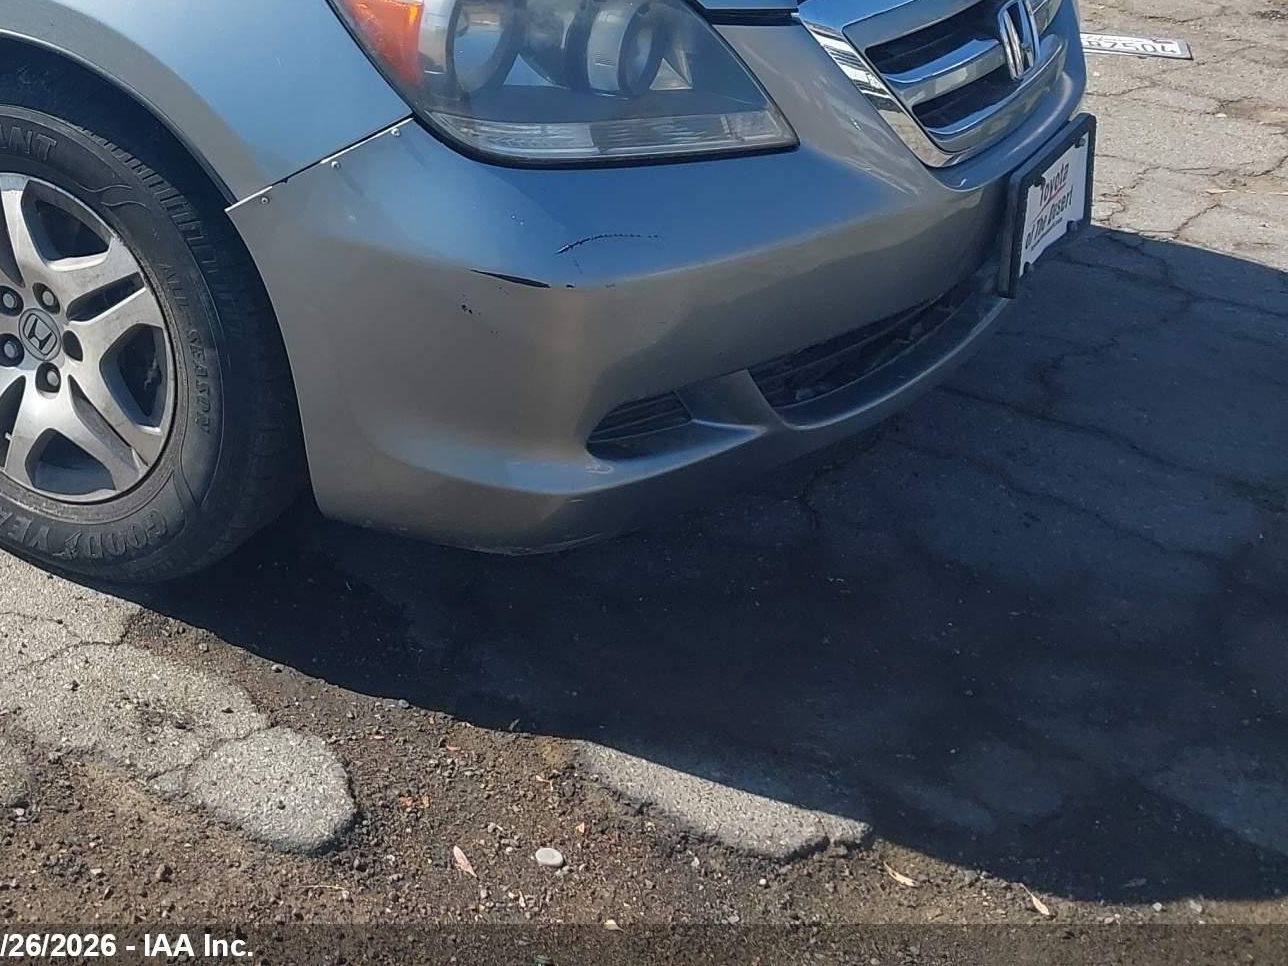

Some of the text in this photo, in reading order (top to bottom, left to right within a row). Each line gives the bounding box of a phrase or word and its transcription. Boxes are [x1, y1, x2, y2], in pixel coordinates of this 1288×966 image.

[1039, 162, 1069, 207] Toyota
[1025, 224, 1036, 250] of
[1034, 214, 1048, 240] The
[1048, 185, 1073, 225] Desert
